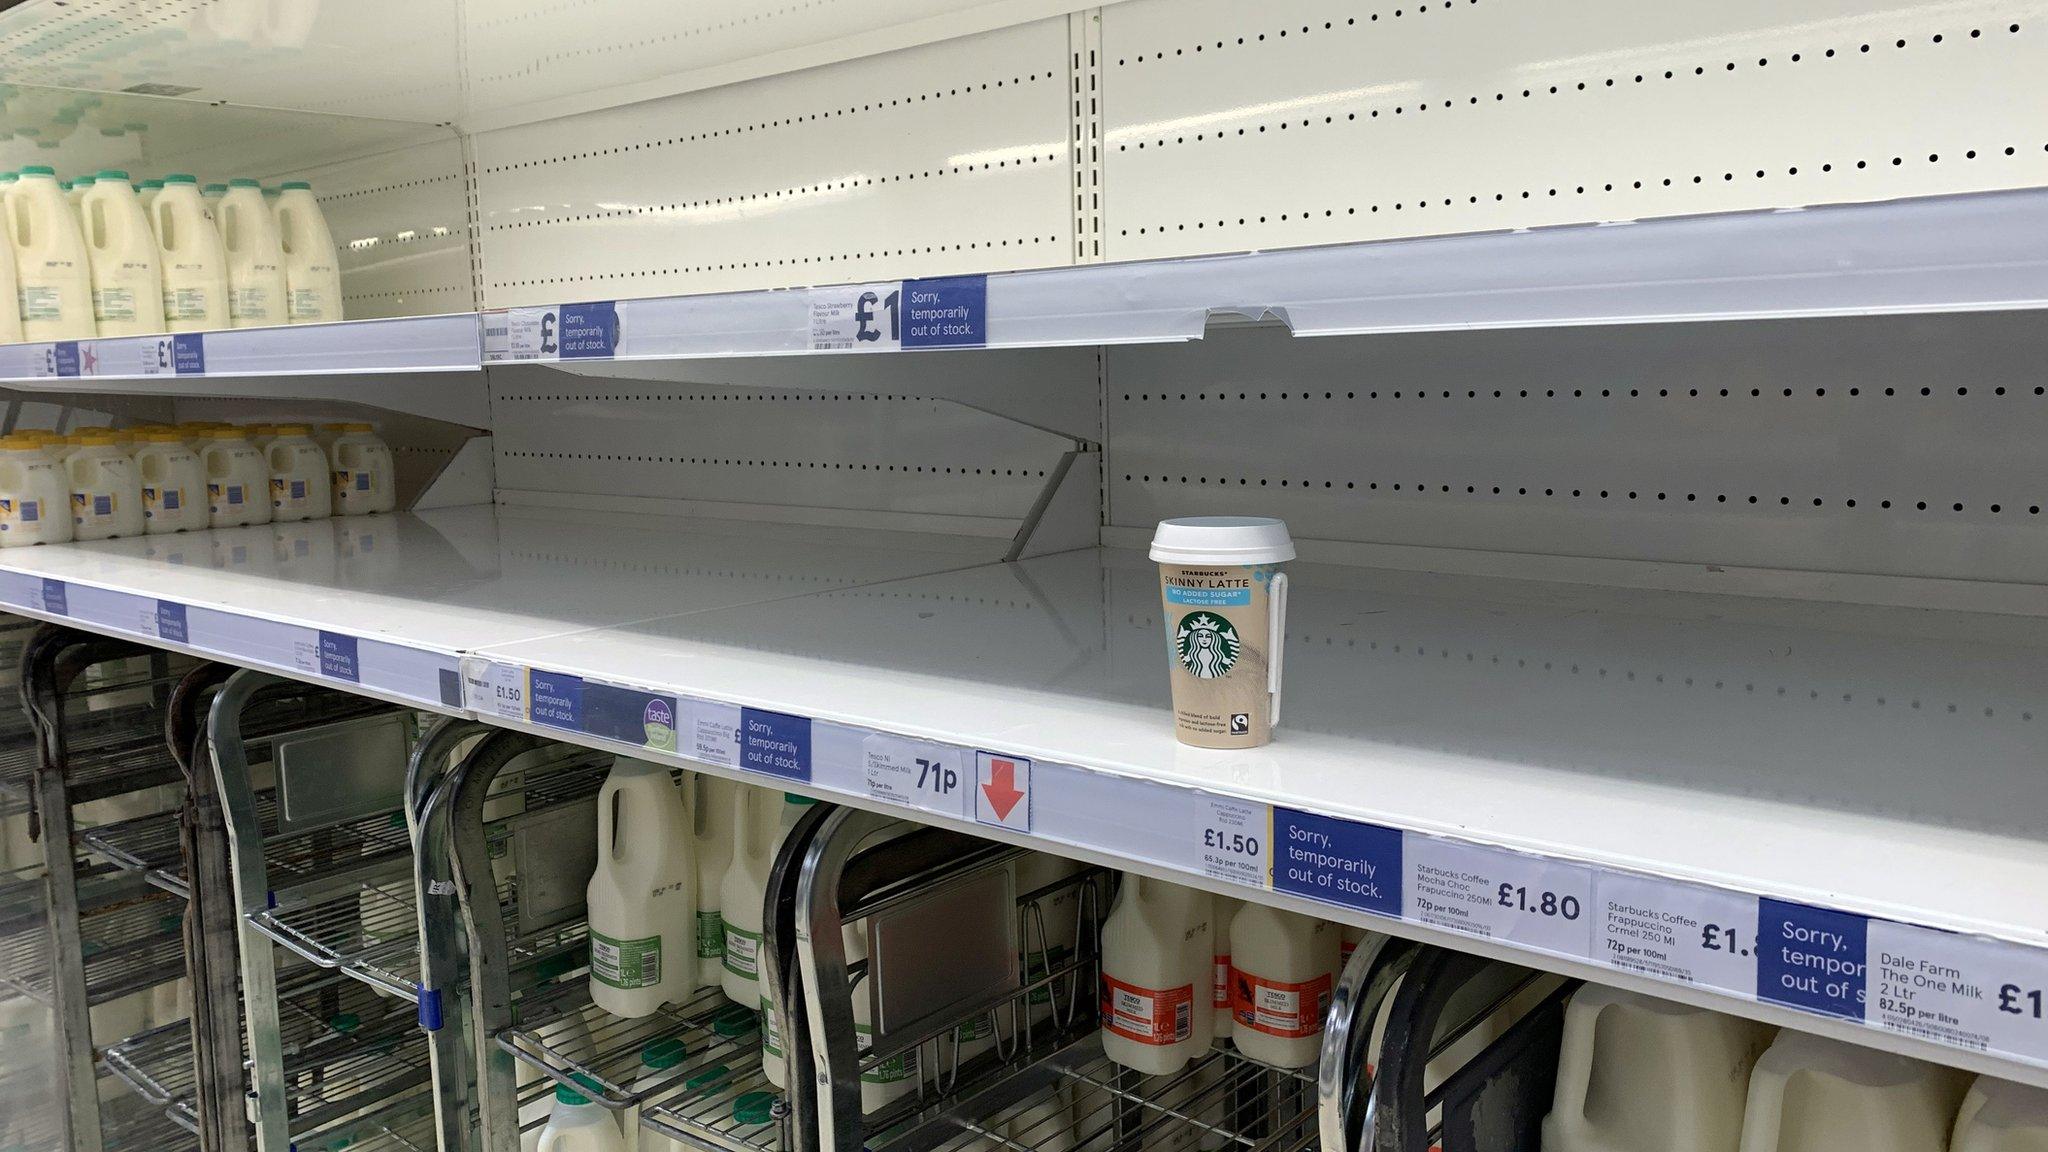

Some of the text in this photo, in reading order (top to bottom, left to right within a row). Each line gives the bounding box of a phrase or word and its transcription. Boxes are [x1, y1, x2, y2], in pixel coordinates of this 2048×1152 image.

[911, 291, 940, 304] Sorry,
[855, 290, 899, 342] £1
[911, 306, 969, 322] temporarily
[565, 326, 604, 338] temporarily
[911, 323, 974, 336] out of stock.
[158, 340, 174, 369] £1
[578, 342, 585, 350] of
[1165, 576, 1249, 588] SKINNY LATTE
[497, 685, 520, 701] £1.50
[535, 679, 555, 693] Sorry,
[535, 693, 572, 710] temporarily
[535, 707, 575, 722] out of stock.
[648, 707, 670, 724] taste
[748, 719, 773, 735] Sorry,
[748, 735, 798, 757] temporarily
[748, 751, 801, 770] out of stock.
[916, 758, 957, 794] 71p
[1204, 828, 1259, 856] £1.50
[1289, 825, 1332, 849] Sorry,
[1237, 862, 1258, 872] 100ml
[1289, 845, 1377, 880] temporarily
[1288, 867, 1313, 884] out
[1317, 872, 1333, 887] of
[1337, 877, 1383, 899] stock.
[1417, 863, 1490, 886] Starbucks Coffee
[1417, 874, 1470, 892] Mocha Choc
[1417, 883, 1493, 906] Frapuccino 250Ml
[1498, 883, 1580, 920] £1.80
[1416, 897, 1433, 912] 72p
[1448, 906, 1469, 917] 100ml
[1607, 901, 1697, 928] Starbucks Coffee
[1607, 913, 1673, 935] Frappuccino
[1607, 924, 1639, 939] Crmel
[1642, 930, 1661, 943] 250
[1702, 923, 1758, 958] £1.
[1782, 921, 1847, 952] Sorry,
[1606, 938, 1667, 960] 72p per 100ml
[1881, 952, 1960, 979] Dale Farm
[1781, 974, 1818, 994] out
[1826, 982, 1849, 1000] of
[1880, 967, 1983, 1000] The One Milk
[1880, 983, 1916, 1000] 2 Ltr
[1879, 997, 1959, 1026] 82.5p per litre
